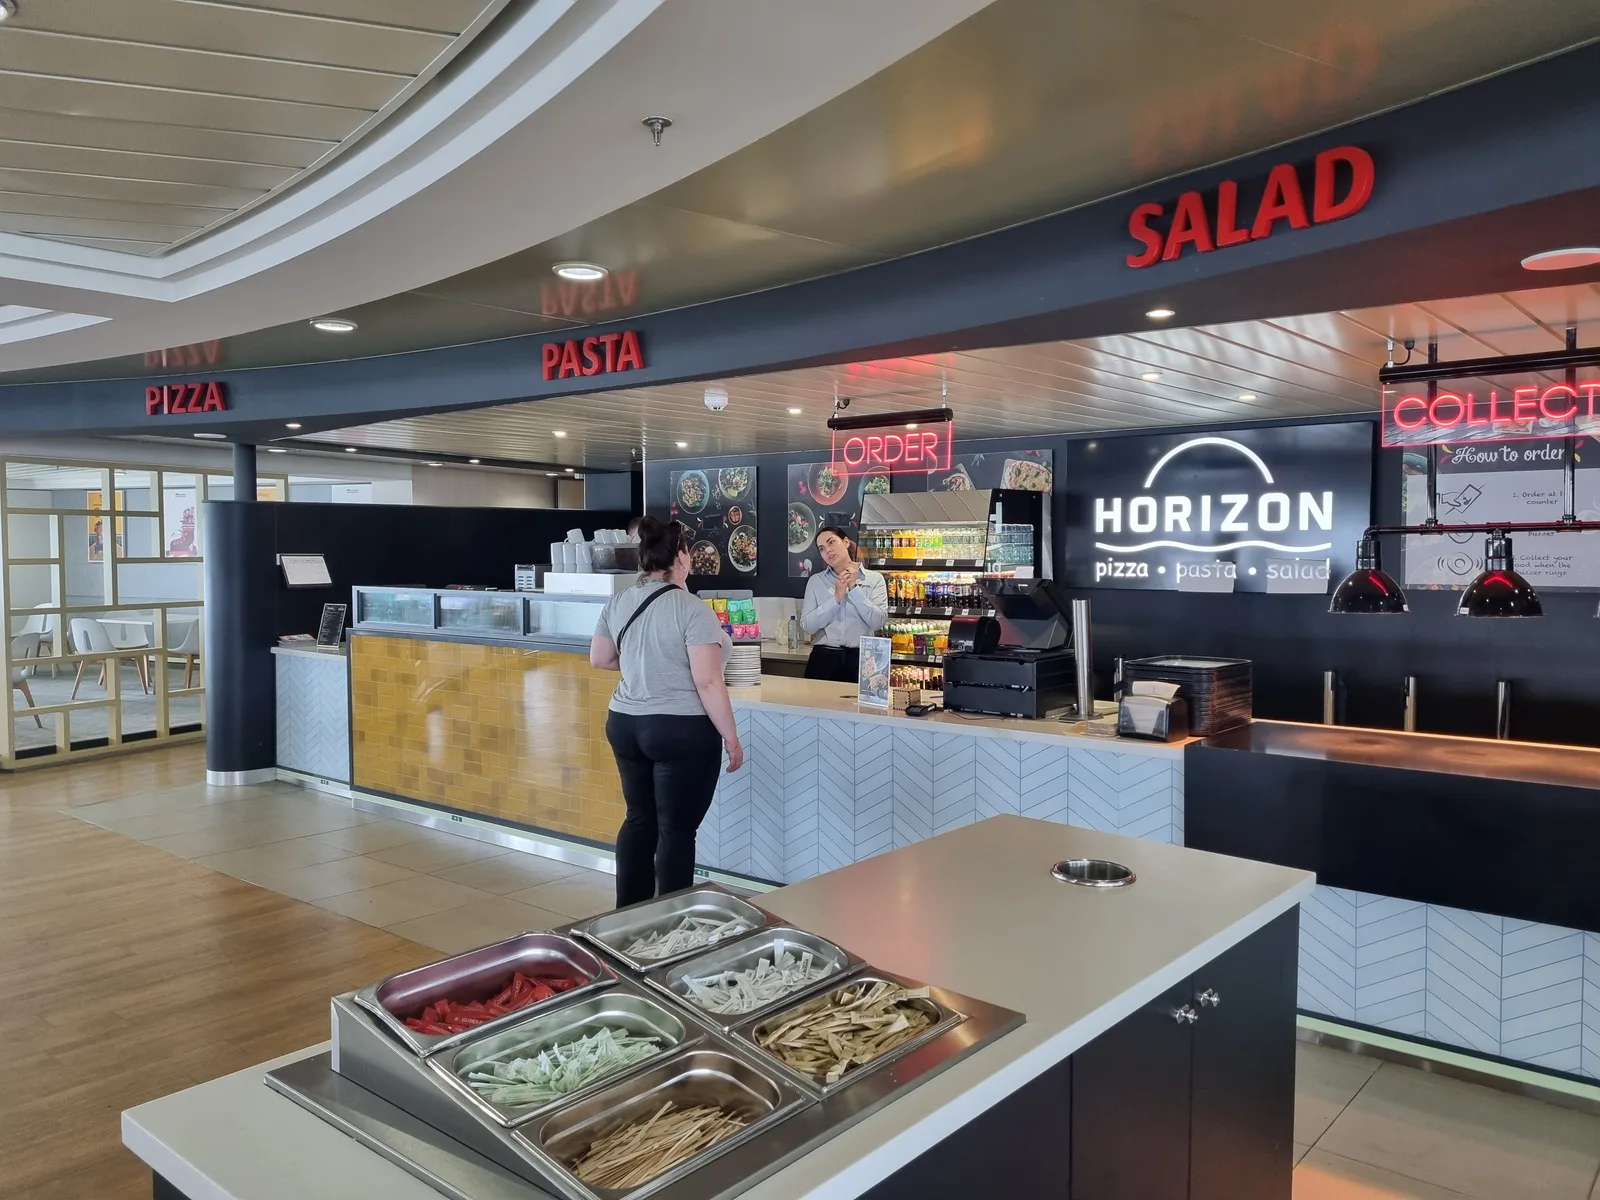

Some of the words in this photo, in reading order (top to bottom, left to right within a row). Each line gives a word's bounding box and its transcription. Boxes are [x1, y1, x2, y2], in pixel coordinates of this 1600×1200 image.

[1126, 145, 1375, 268] SALAD
[541, 330, 645, 381] PASTA
[145, 381, 227, 416] PIZZA
[1393, 383, 1600, 430] COLLECT
[843, 432, 938, 465] ORDER
[1451, 445, 1500, 465] How
[1500, 445, 1519, 462] to
[1524, 443, 1565, 462] order
[1095, 491, 1333, 533] HORIZON
[1096, 557, 1149, 583] pizza
[1545, 568, 1567, 577] rings
[1553, 556, 1573, 564] your
